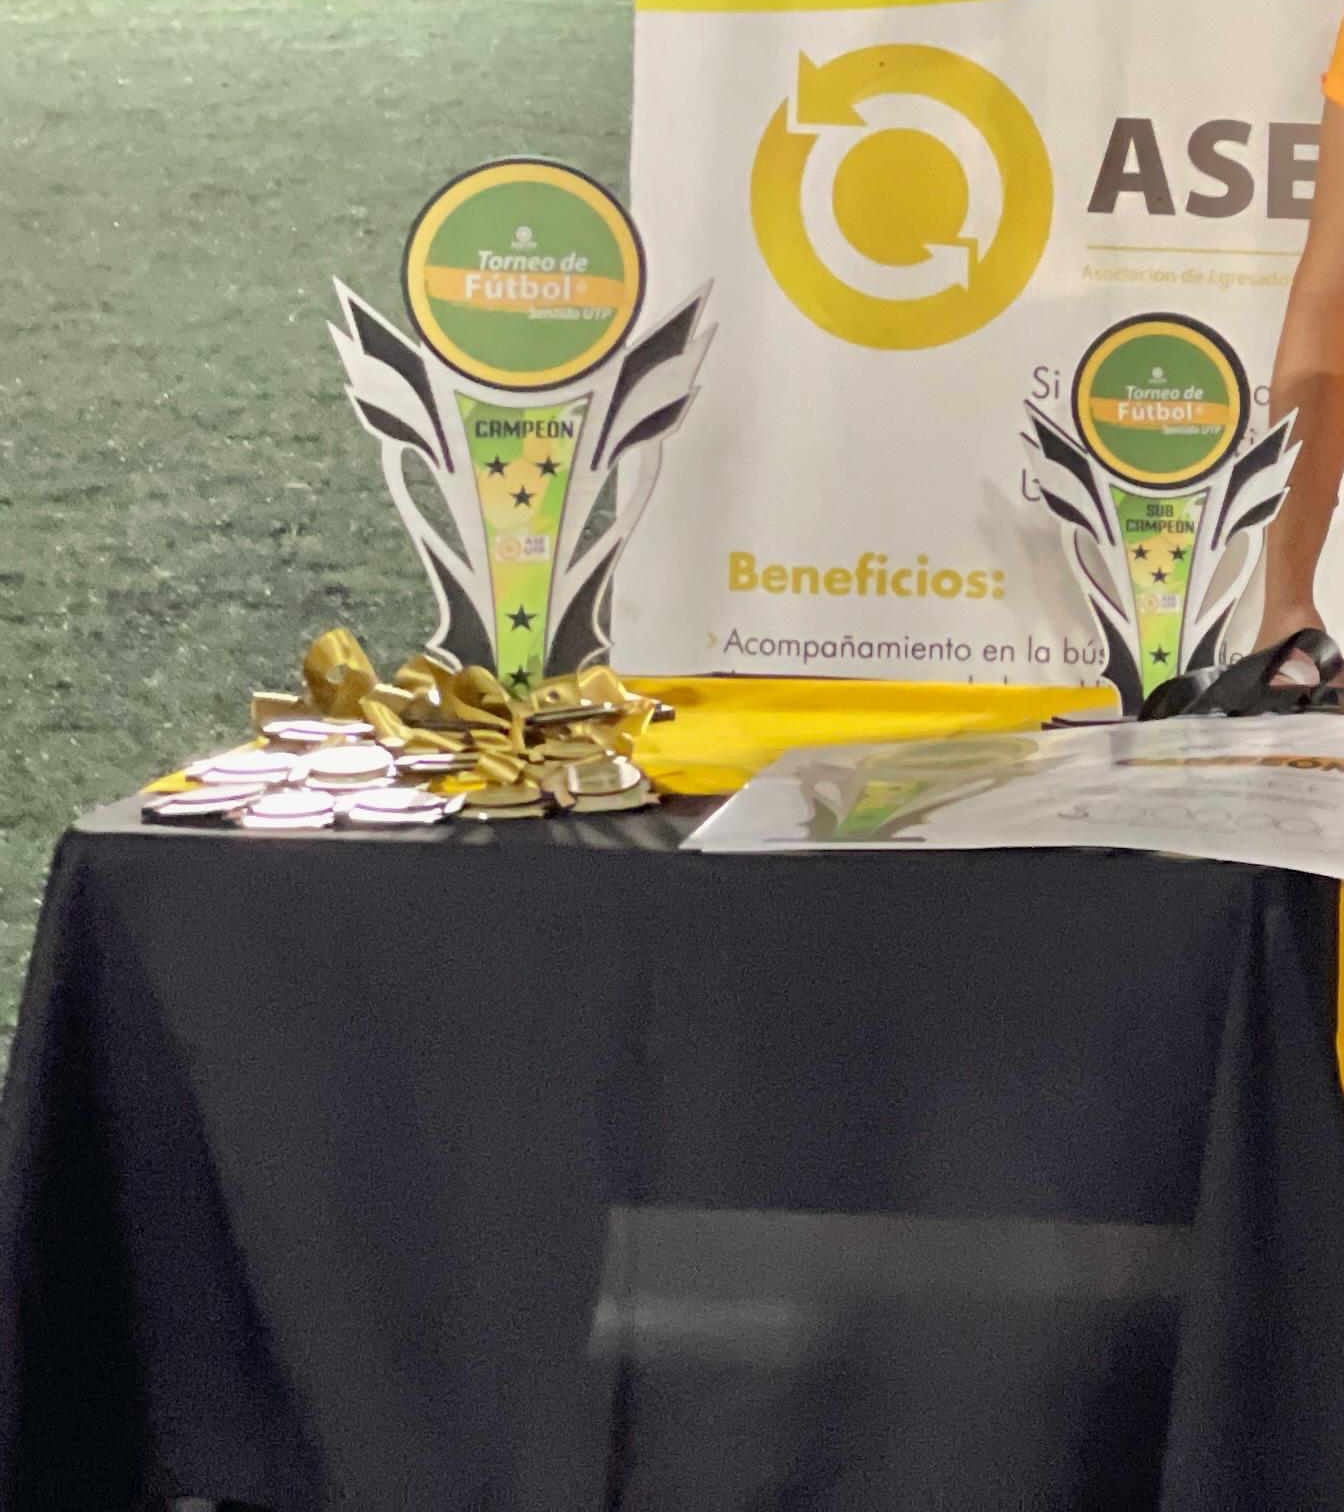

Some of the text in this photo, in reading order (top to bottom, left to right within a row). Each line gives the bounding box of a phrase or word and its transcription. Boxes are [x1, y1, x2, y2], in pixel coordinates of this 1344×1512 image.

[478, 250, 588, 272] Torneo de
[464, 274, 571, 300] Fútbol
[583, 308, 612, 320] UTP
[1032, 366, 1060, 399] Si
[1126, 385, 1204, 400] Torneo de
[1118, 401, 1193, 421] Fútbol
[475, 416, 574, 438] CAMPEÓN
[1146, 504, 1174, 518] SUB
[728, 551, 1006, 600] Beneficios:
[723, 628, 972, 665] Acompañamiento
[982, 643, 1015, 663] en
[1028, 637, 1050, 663] la
